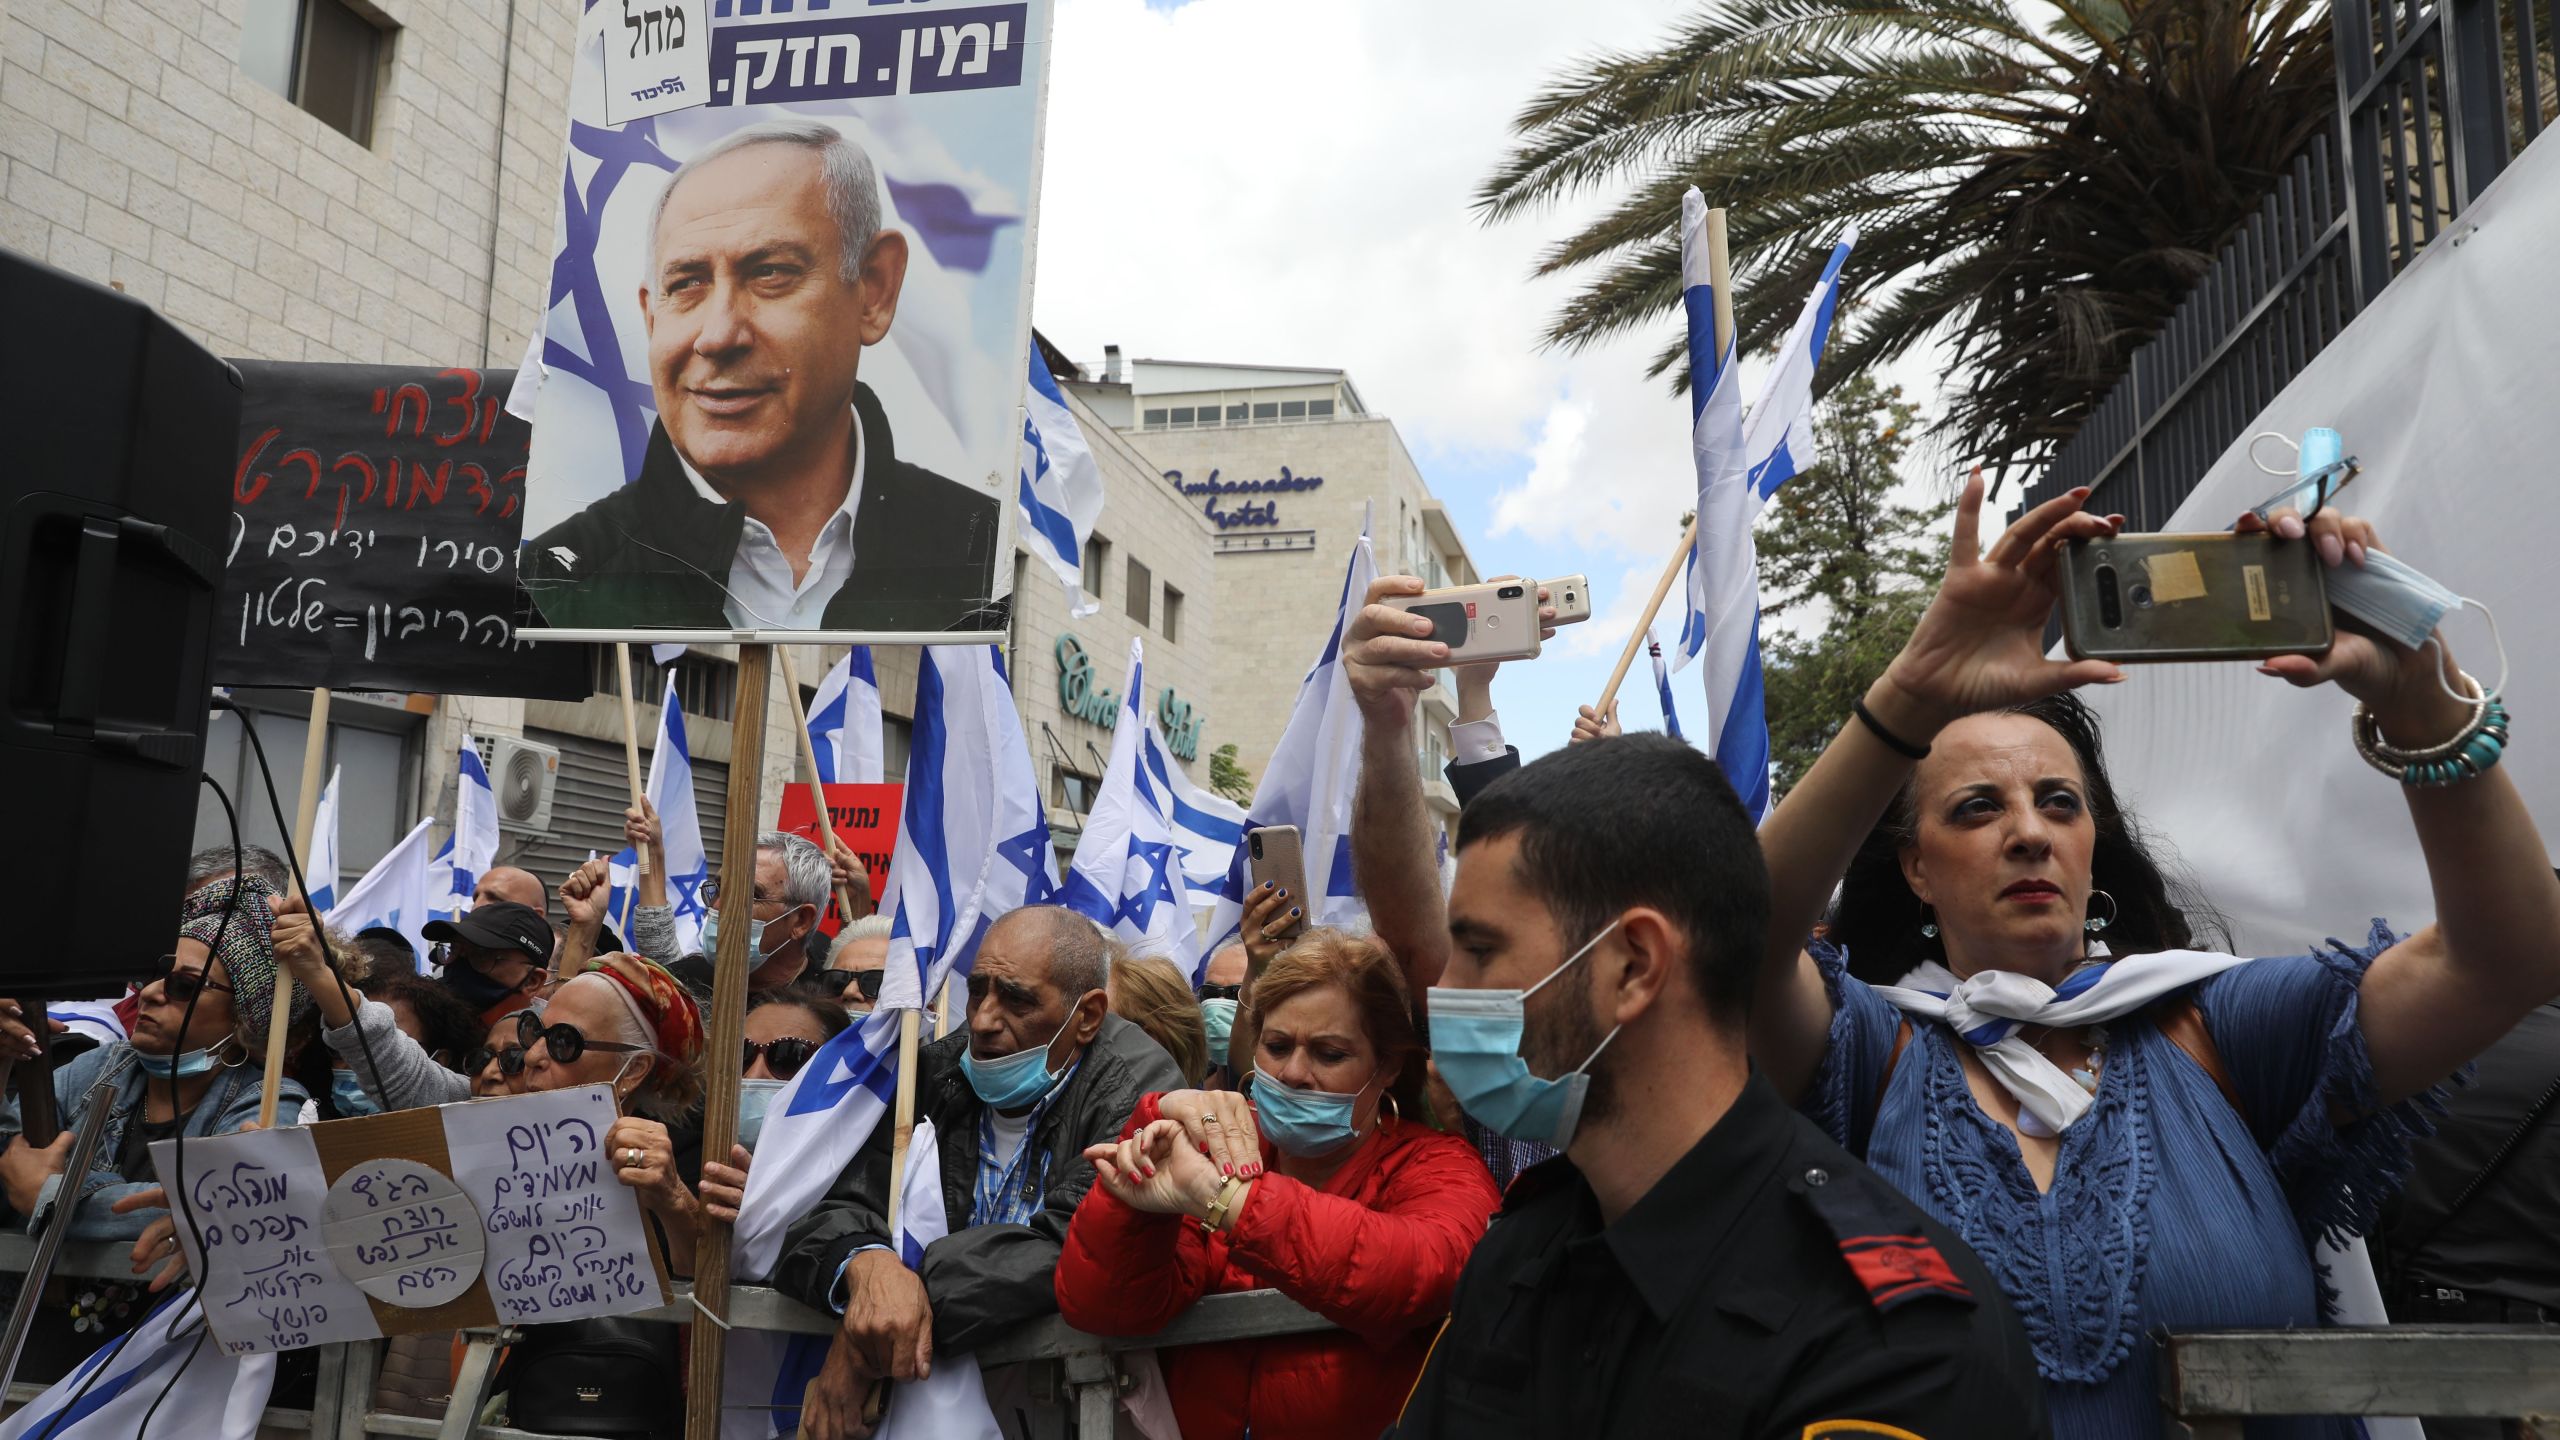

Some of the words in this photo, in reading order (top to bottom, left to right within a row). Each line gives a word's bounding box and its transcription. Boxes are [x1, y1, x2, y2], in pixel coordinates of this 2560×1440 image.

[622, 0, 686, 59] מחל
[716, 33, 861, 106] חזק.
[877, 20, 1010, 96] ימין.
[630, 76, 686, 102] הליכוד
[371, 368, 530, 448] וצחי
[234, 427, 527, 531] הדמוקרט
[1163, 466, 1324, 496] Ambassador
[267, 523, 375, 558] ידיכם
[417, 535, 520, 573] סירו
[1223, 536, 1316, 550] TIQUE
[810, 807, 880, 833] נתניה,
[382, 1206, 445, 1237] רוצח
[488, 1203, 543, 1233] למשפט
[555, 1193, 605, 1222] אותי
[205, 1214, 309, 1251] תפרסם
[406, 1231, 458, 1259] את
[243, 1245, 316, 1275] את
[357, 1245, 399, 1265] נפש
[522, 1226, 606, 1273] היום
[573, 1250, 634, 1277] מתחיל
[225, 1270, 323, 1308] הקלטות
[398, 1267, 457, 1296] העם
[498, 1258, 562, 1291] המשפט
[549, 1281, 596, 1308] משפט
[257, 1304, 328, 1332] פושע
[264, 1332, 309, 1349] פושע
